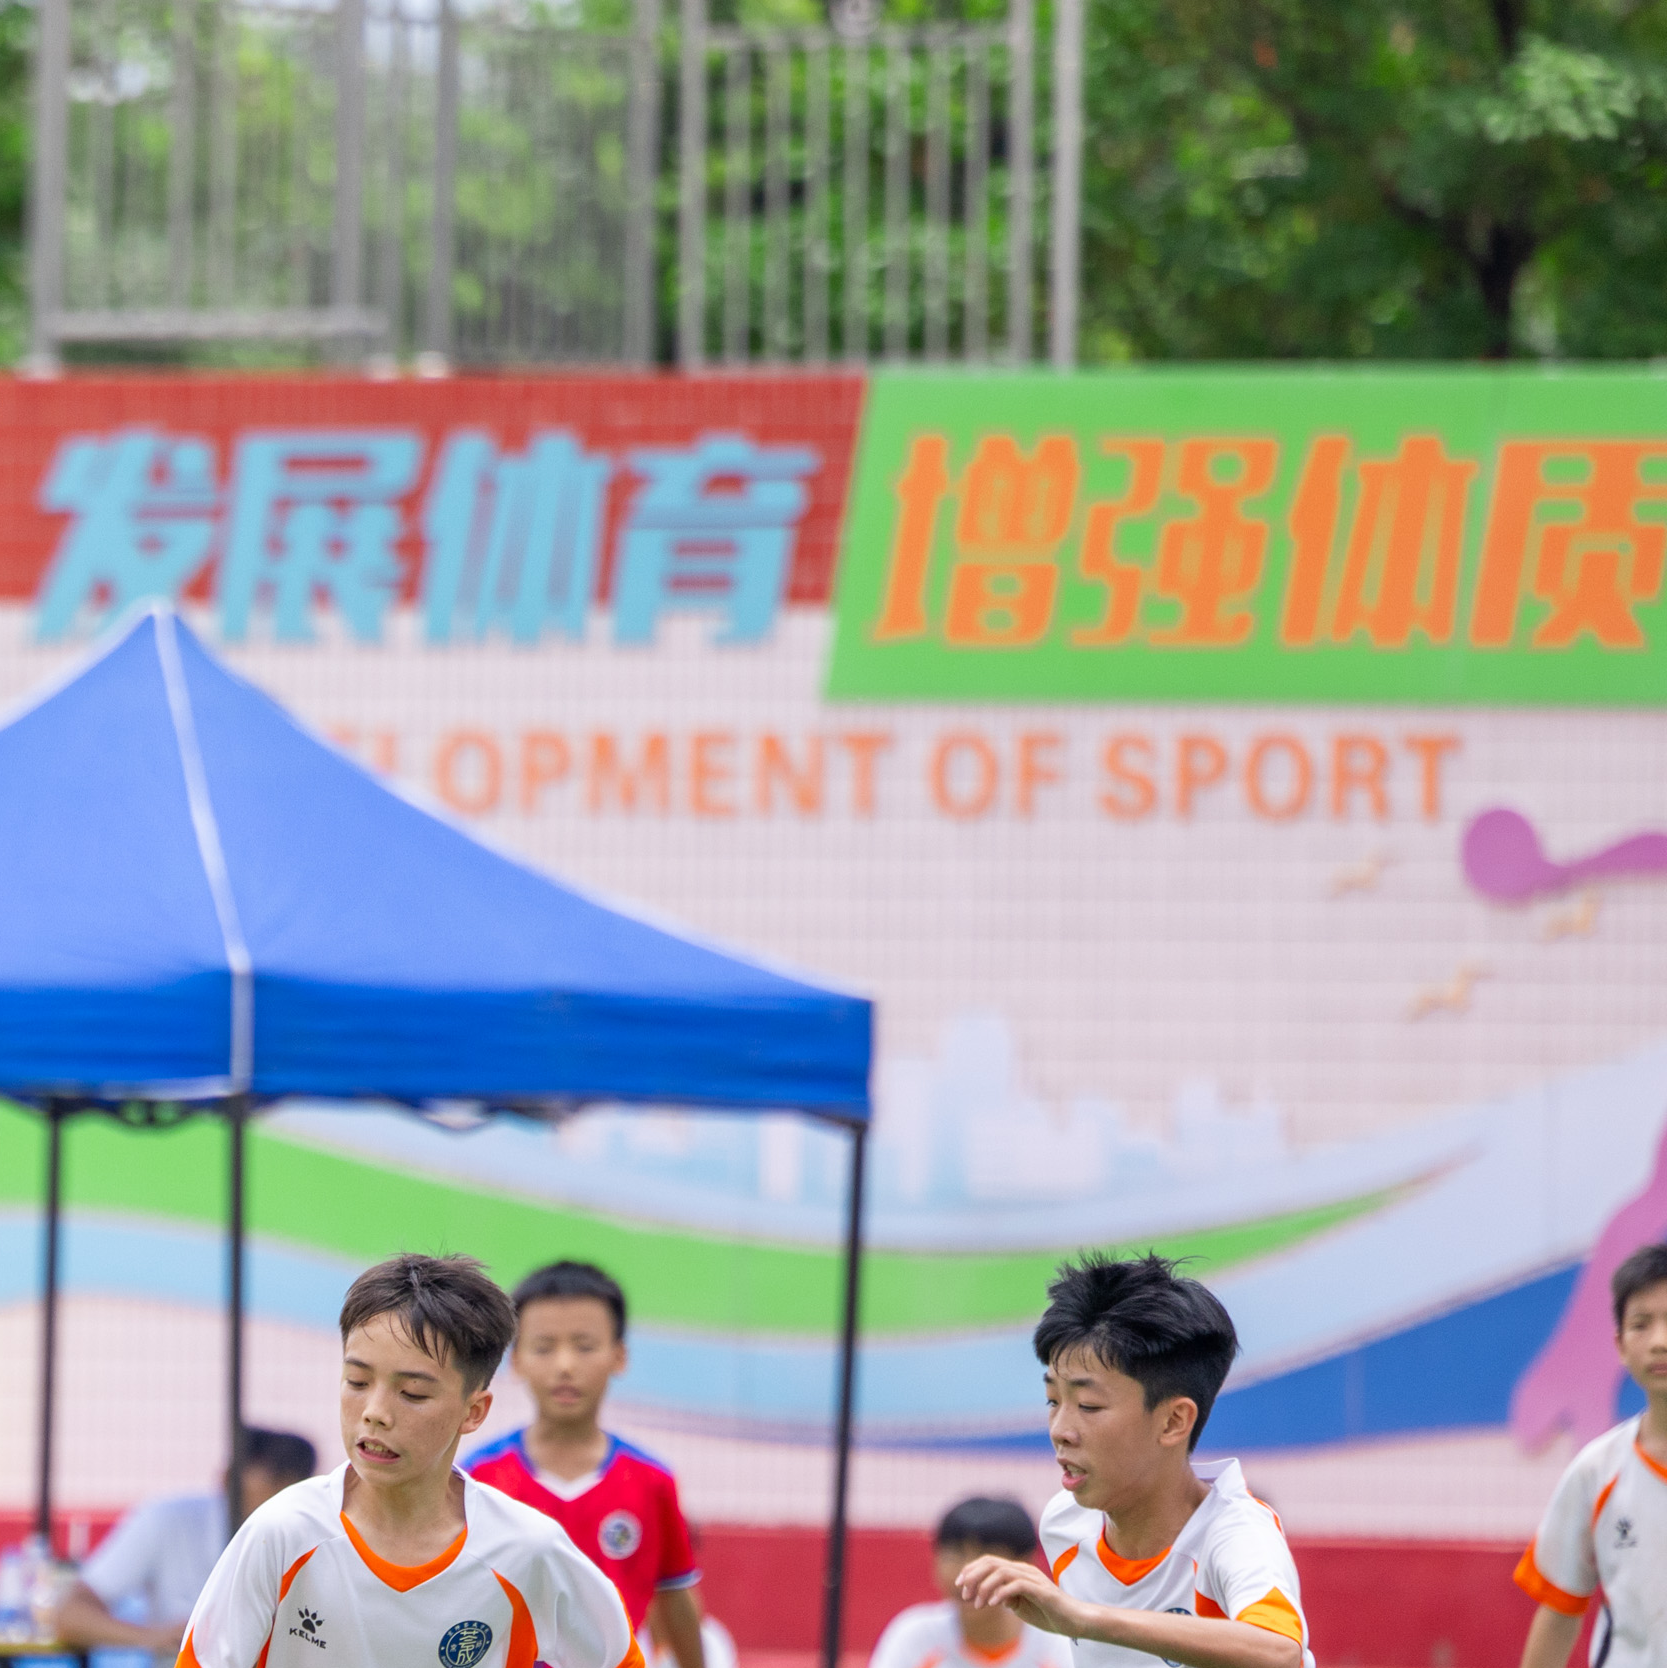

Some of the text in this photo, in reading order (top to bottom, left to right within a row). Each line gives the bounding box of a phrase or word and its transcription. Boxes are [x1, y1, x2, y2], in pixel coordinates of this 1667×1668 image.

[33, 424, 1667, 650] 发展体育 增强体质
[322, 728, 1463, 823] OPMENT OF SPORT
[288, 1627, 327, 1650] KELME
